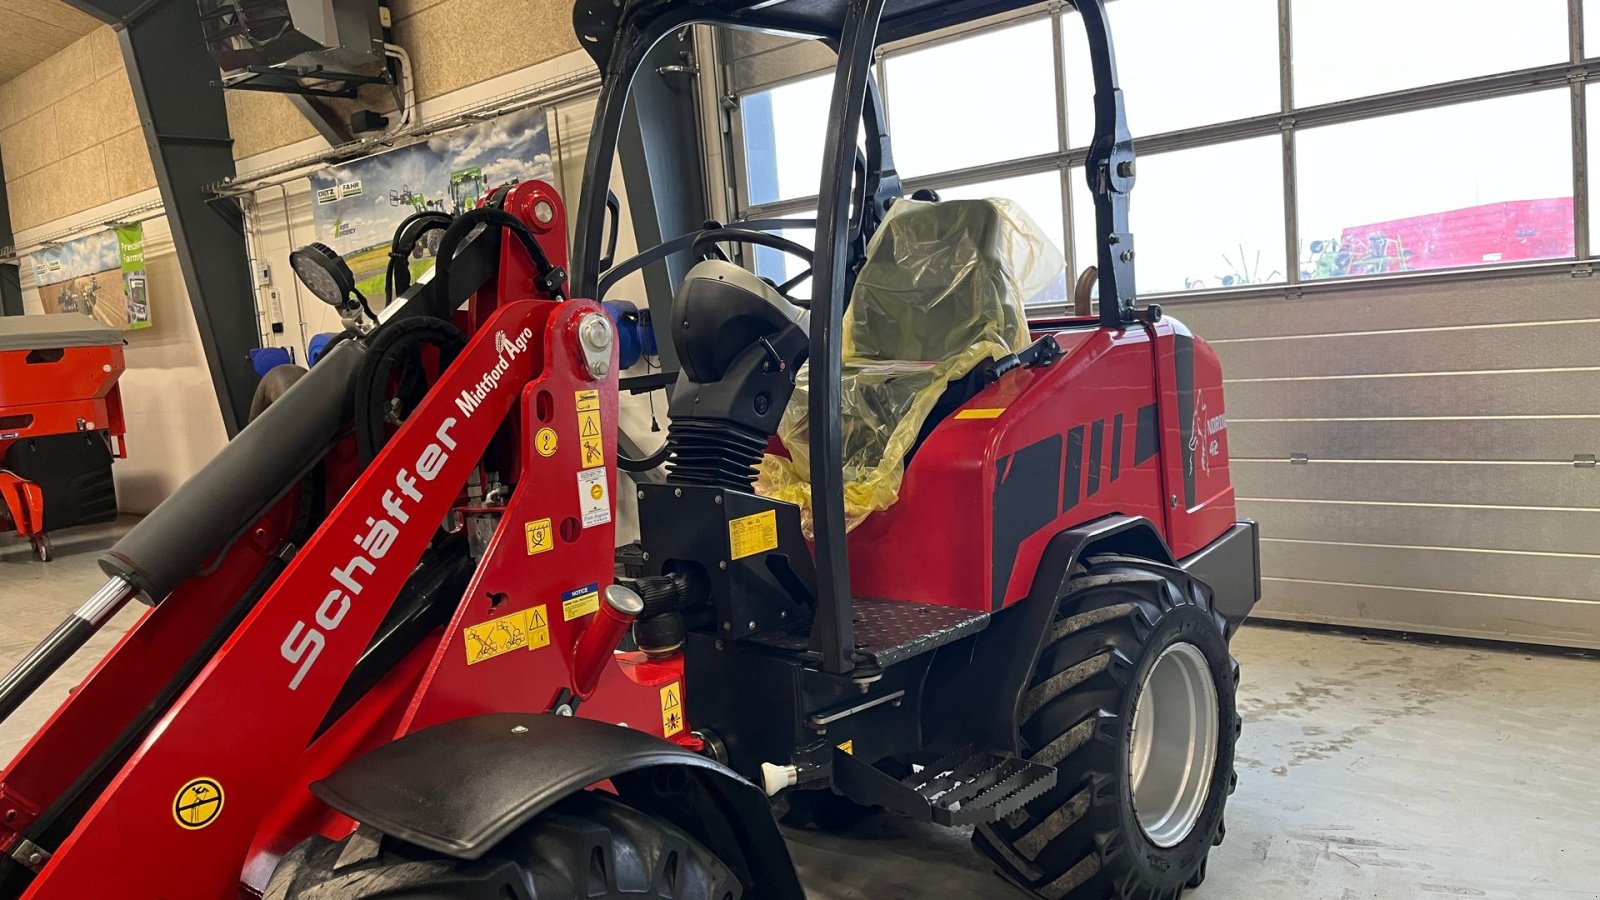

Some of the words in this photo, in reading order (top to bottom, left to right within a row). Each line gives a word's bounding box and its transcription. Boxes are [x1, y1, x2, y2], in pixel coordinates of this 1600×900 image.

[342, 182, 360, 191] FAHR
[455, 354, 510, 418] Midtfjord
[503, 327, 533, 361] Agro
[280, 417, 457, 691] Schäffer
[571, 587, 588, 597] NOTICE
